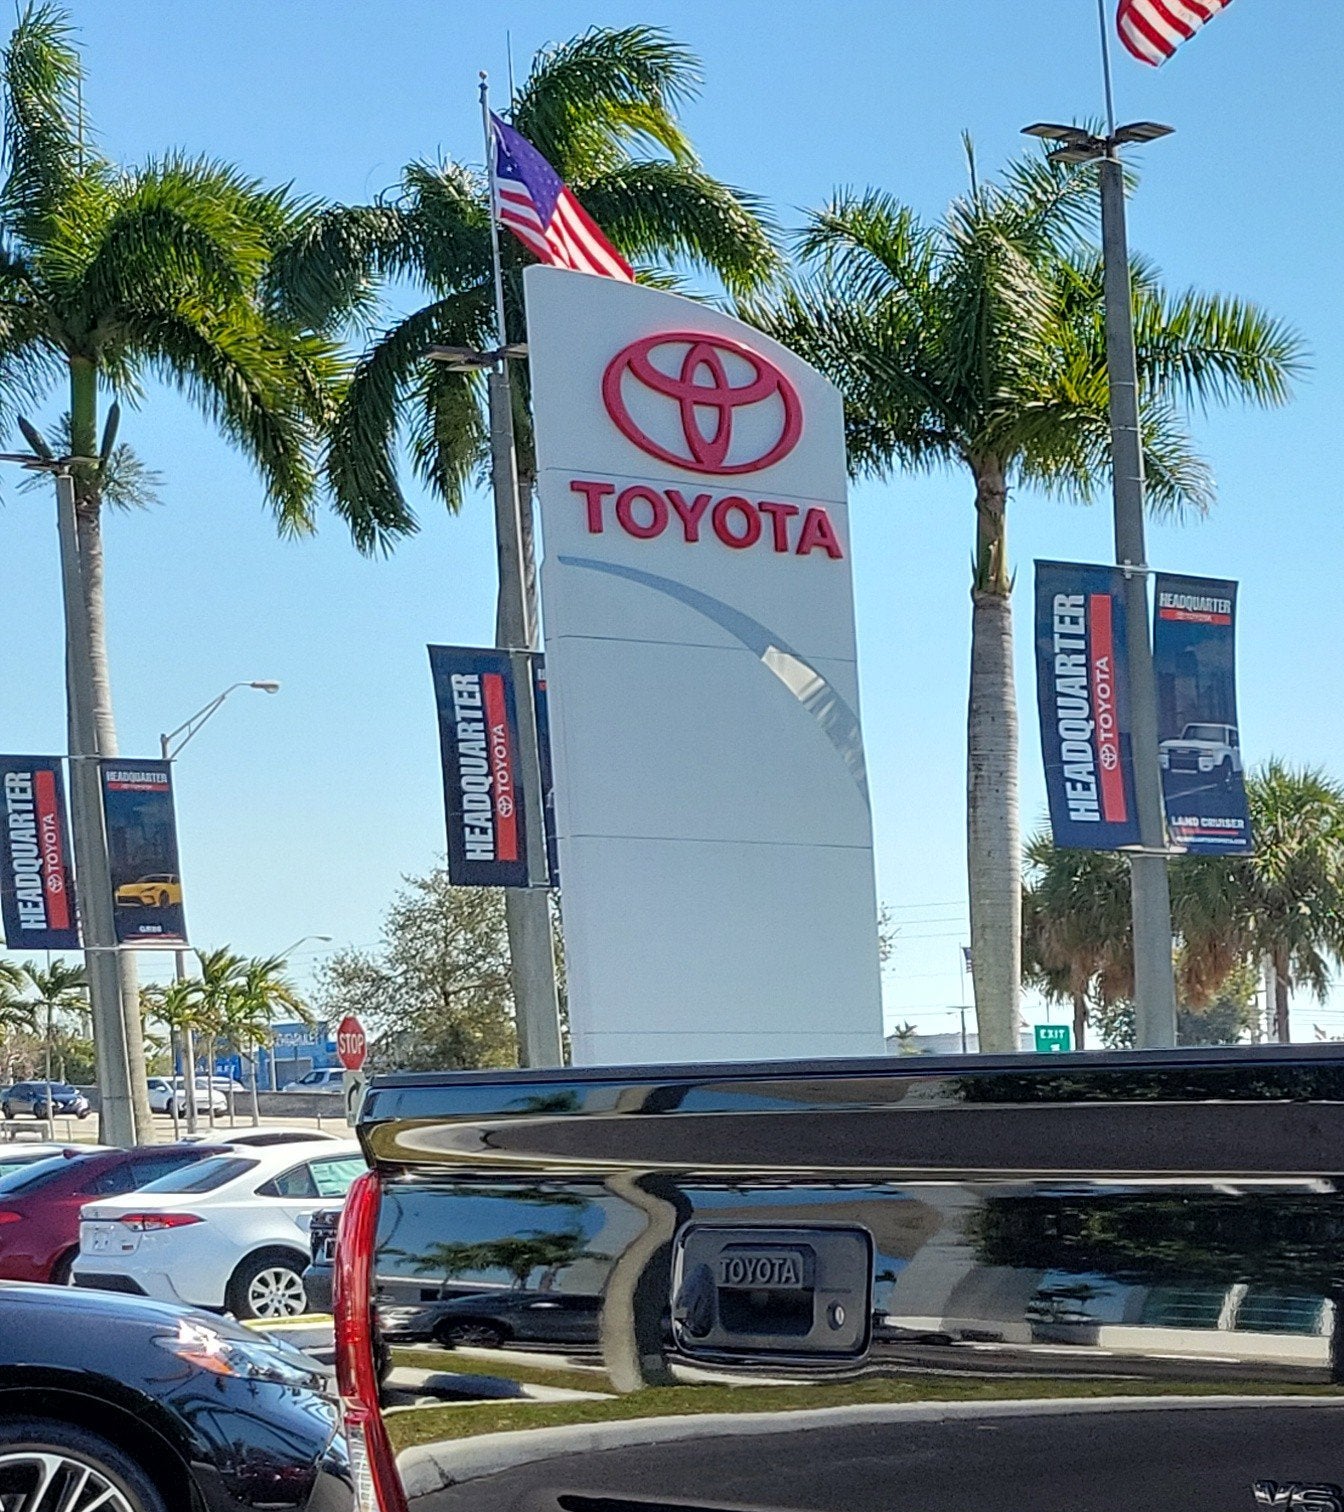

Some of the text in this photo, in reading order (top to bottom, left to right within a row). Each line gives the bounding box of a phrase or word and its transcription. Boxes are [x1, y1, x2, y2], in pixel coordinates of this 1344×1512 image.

[569, 479, 844, 561] TOYOTA
[1160, 592, 1231, 613] HEADQUARTER
[1053, 594, 1101, 822] HEADQUARTER
[1094, 656, 1114, 742] TOYOTA
[450, 672, 496, 862] HEADQUARTER
[493, 724, 511, 796] TOYOTA
[4, 771, 48, 930] HEADQUARTER
[42, 812, 59, 875] TOYOTA
[339, 1033, 364, 1055] STOP
[1040, 1029, 1065, 1039] EXIT
[719, 1256, 797, 1284] TOYOTA
